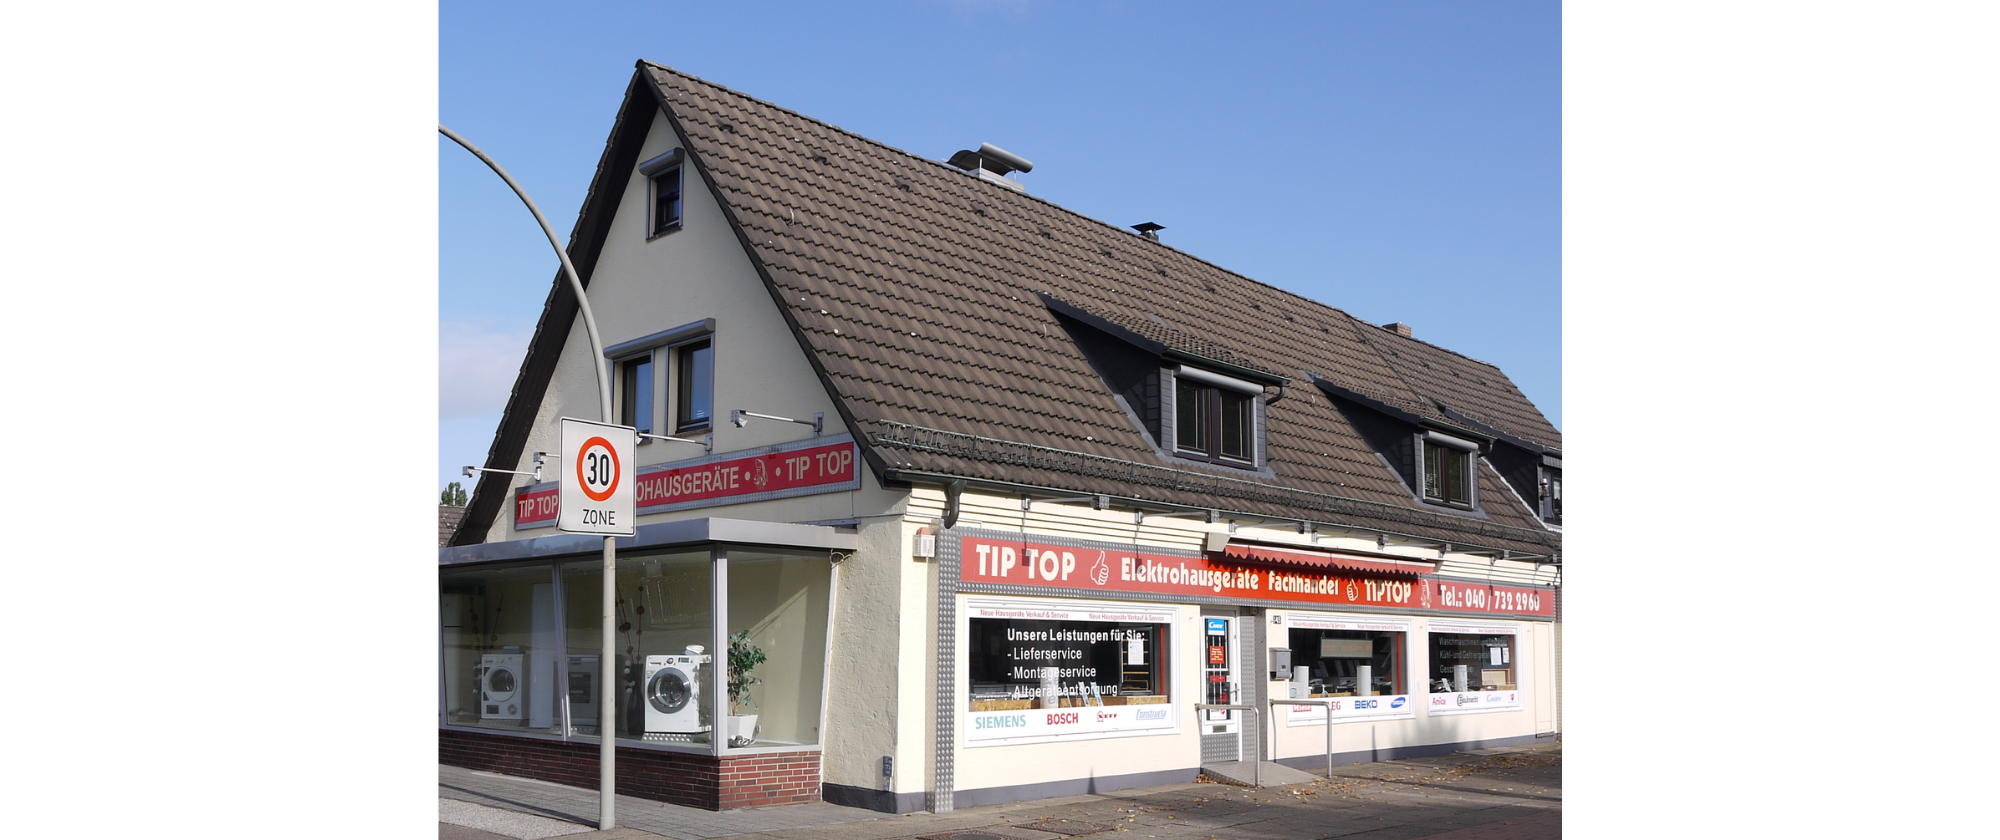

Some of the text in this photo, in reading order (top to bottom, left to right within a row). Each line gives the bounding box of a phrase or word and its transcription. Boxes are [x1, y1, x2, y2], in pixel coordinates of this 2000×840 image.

[588, 452, 609, 486] 30
[786, 450, 852, 480] TIP TOP
[636, 466, 739, 502] OHAUSGERÄTE
[519, 495, 558, 518] TIP TOP
[582, 509, 615, 525] ZONE
[976, 544, 1016, 577] TIP
[1025, 548, 1076, 581] TOP
[1122, 557, 1259, 592] Elektrohausgeräte
[1268, 570, 1338, 596] Fachhandel
[1440, 585, 1462, 607] Tel.:
[1466, 588, 1485, 608] 040
[1487, 590, 1492, 611] /
[1494, 590, 1513, 610] 732
[1516, 593, 1540, 611] 2960
[996, 610, 1024, 618] Hausgeräte
[1008, 628, 1145, 644] Unsere Leistungen für Sie:
[1014, 648, 1082, 660] Lieferservice
[1014, 665, 1096, 679] Montageservice
[1355, 700, 1377, 709] BEKO
[1432, 696, 1446, 705] Amica
[976, 714, 1026, 730] SIEMENS
[1047, 713, 1078, 725] BOSCH
[1136, 708, 1166, 720] Constructa
